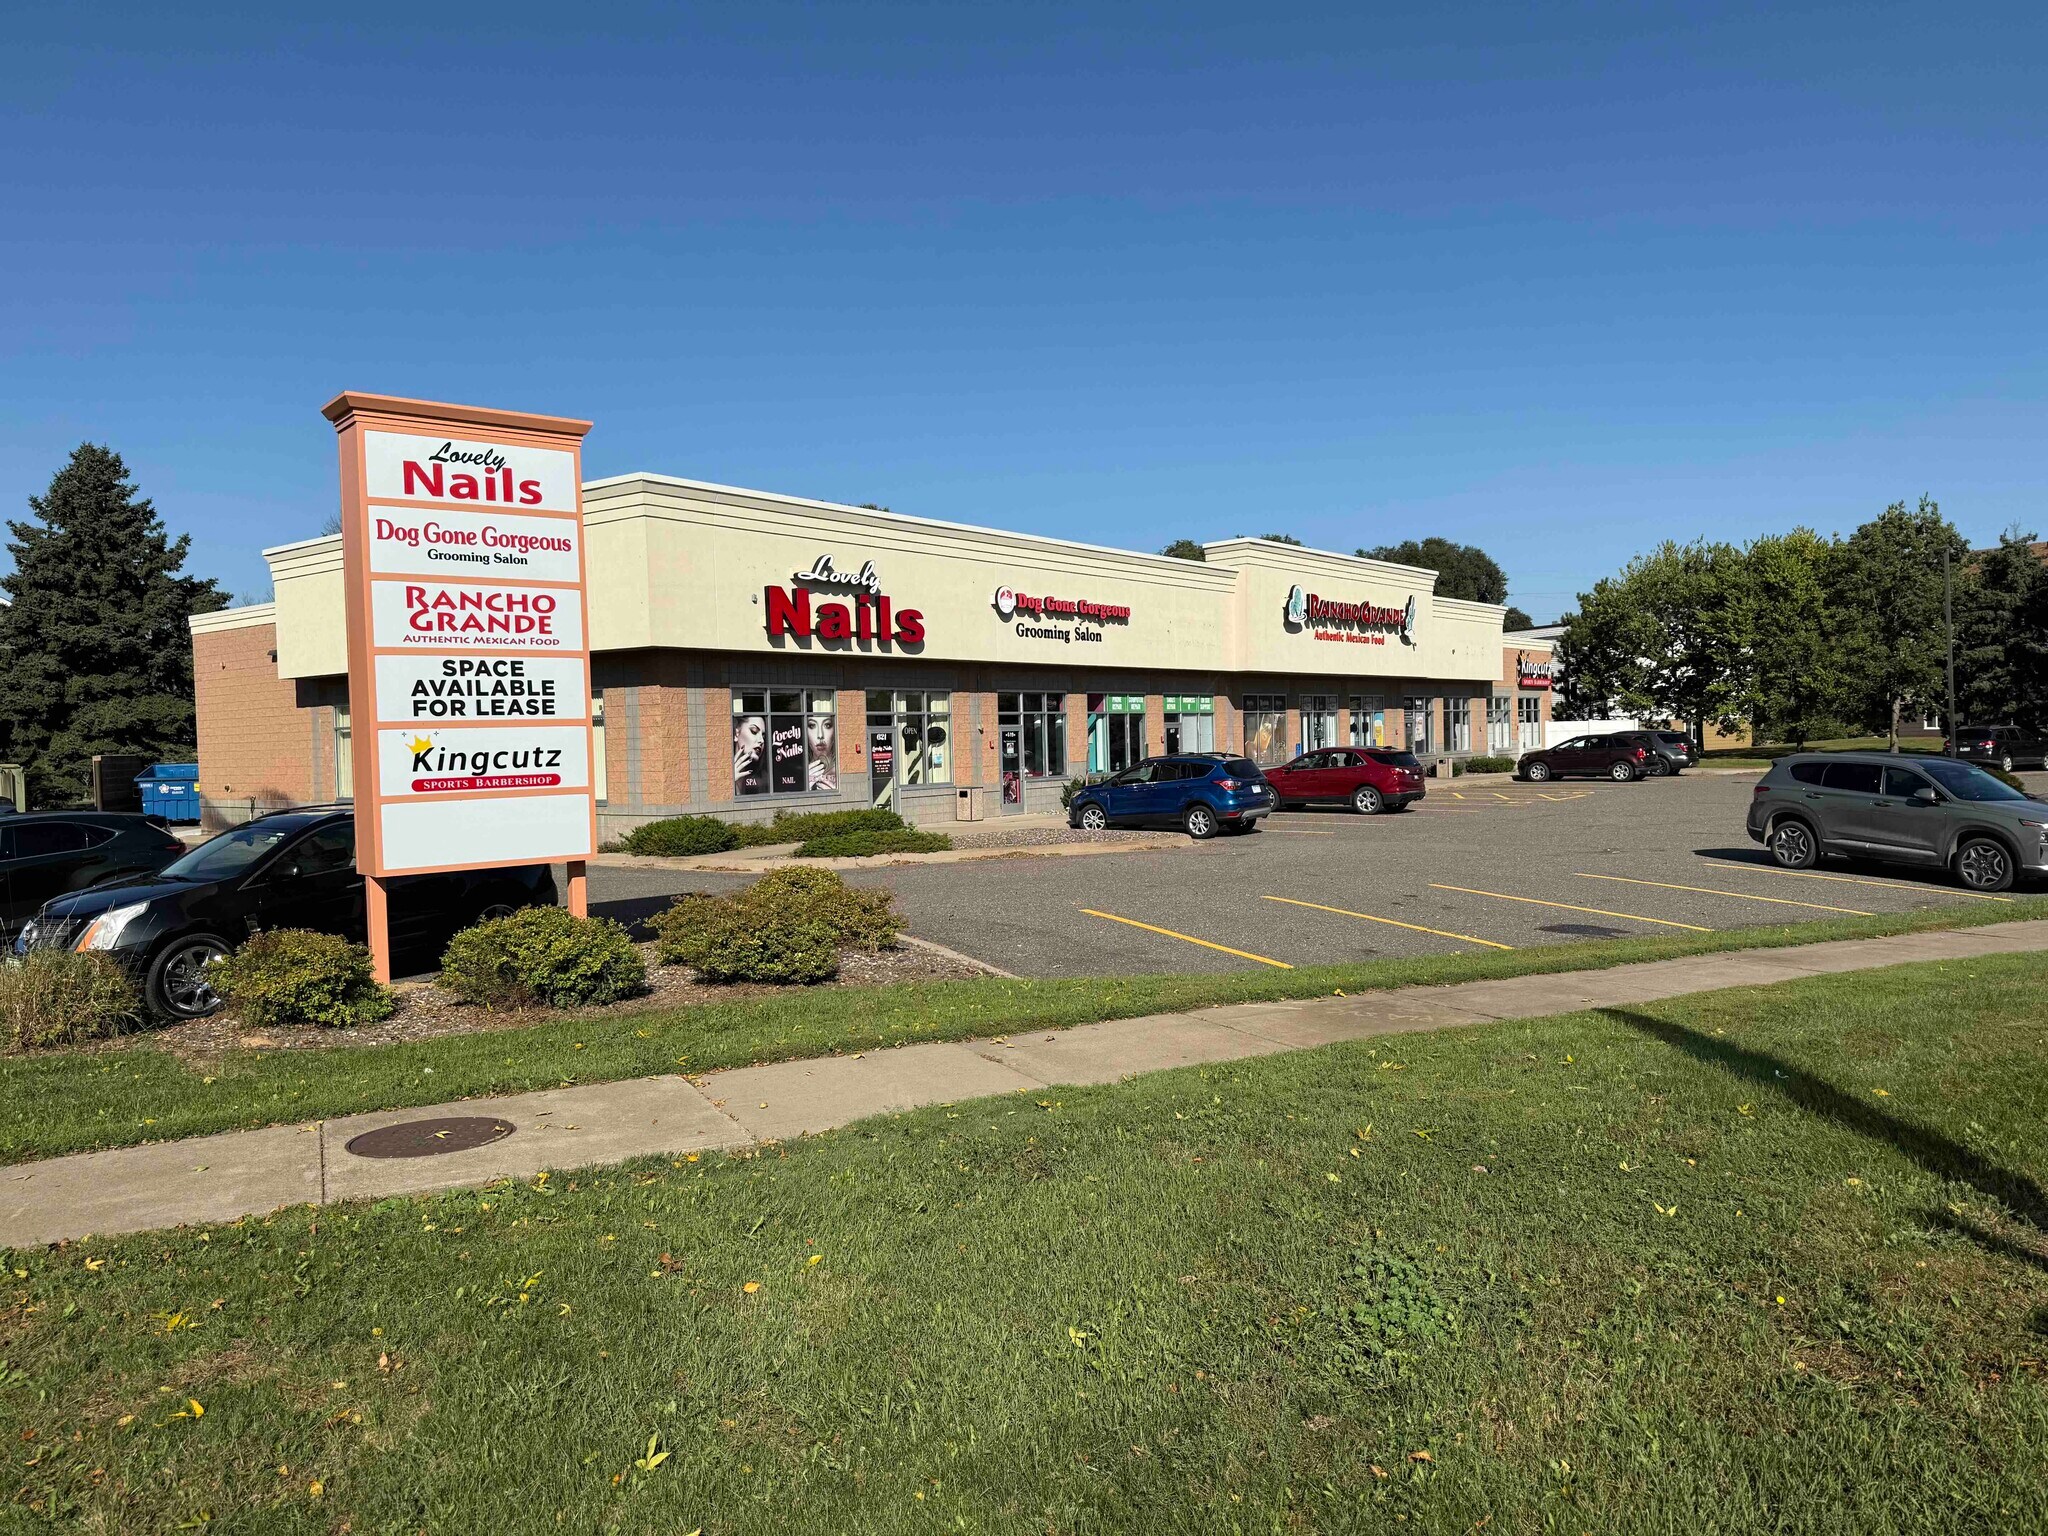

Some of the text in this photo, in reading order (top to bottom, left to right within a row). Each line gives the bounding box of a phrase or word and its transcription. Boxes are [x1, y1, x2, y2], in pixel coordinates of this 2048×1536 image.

[429, 442, 506, 472] Lovely
[403, 460, 543, 504] Nails
[376, 519, 572, 553] Dog Gone Gorgeous
[427, 549, 528, 565] Grooming Salon
[798, 554, 881, 593] Lovely
[405, 585, 556, 614] RANCHO
[1016, 593, 1131, 619] Dog Gone Gorgeous
[1309, 593, 1360, 620] RANCHO
[409, 607, 553, 634] GRANDE
[764, 585, 925, 643] Nails
[403, 634, 560, 646] AUTHENTIC MEXICAN FOOD
[1016, 623, 1102, 643] Grooming Salon
[1314, 629, 1344, 642] Authentic
[1371, 634, 1385, 645] Food
[442, 659, 525, 677] SPACE
[1521, 660, 1552, 678] Kingcutz
[411, 679, 555, 697] AVAILABLE
[412, 698, 556, 717] FOR LEASE
[772, 725, 801, 746] Lovely
[412, 746, 562, 776] Kingcutz
[775, 743, 803, 762] Nails
[423, 776, 553, 790] SPORTS BARBERSHOP
[745, 778, 757, 786] SPA
